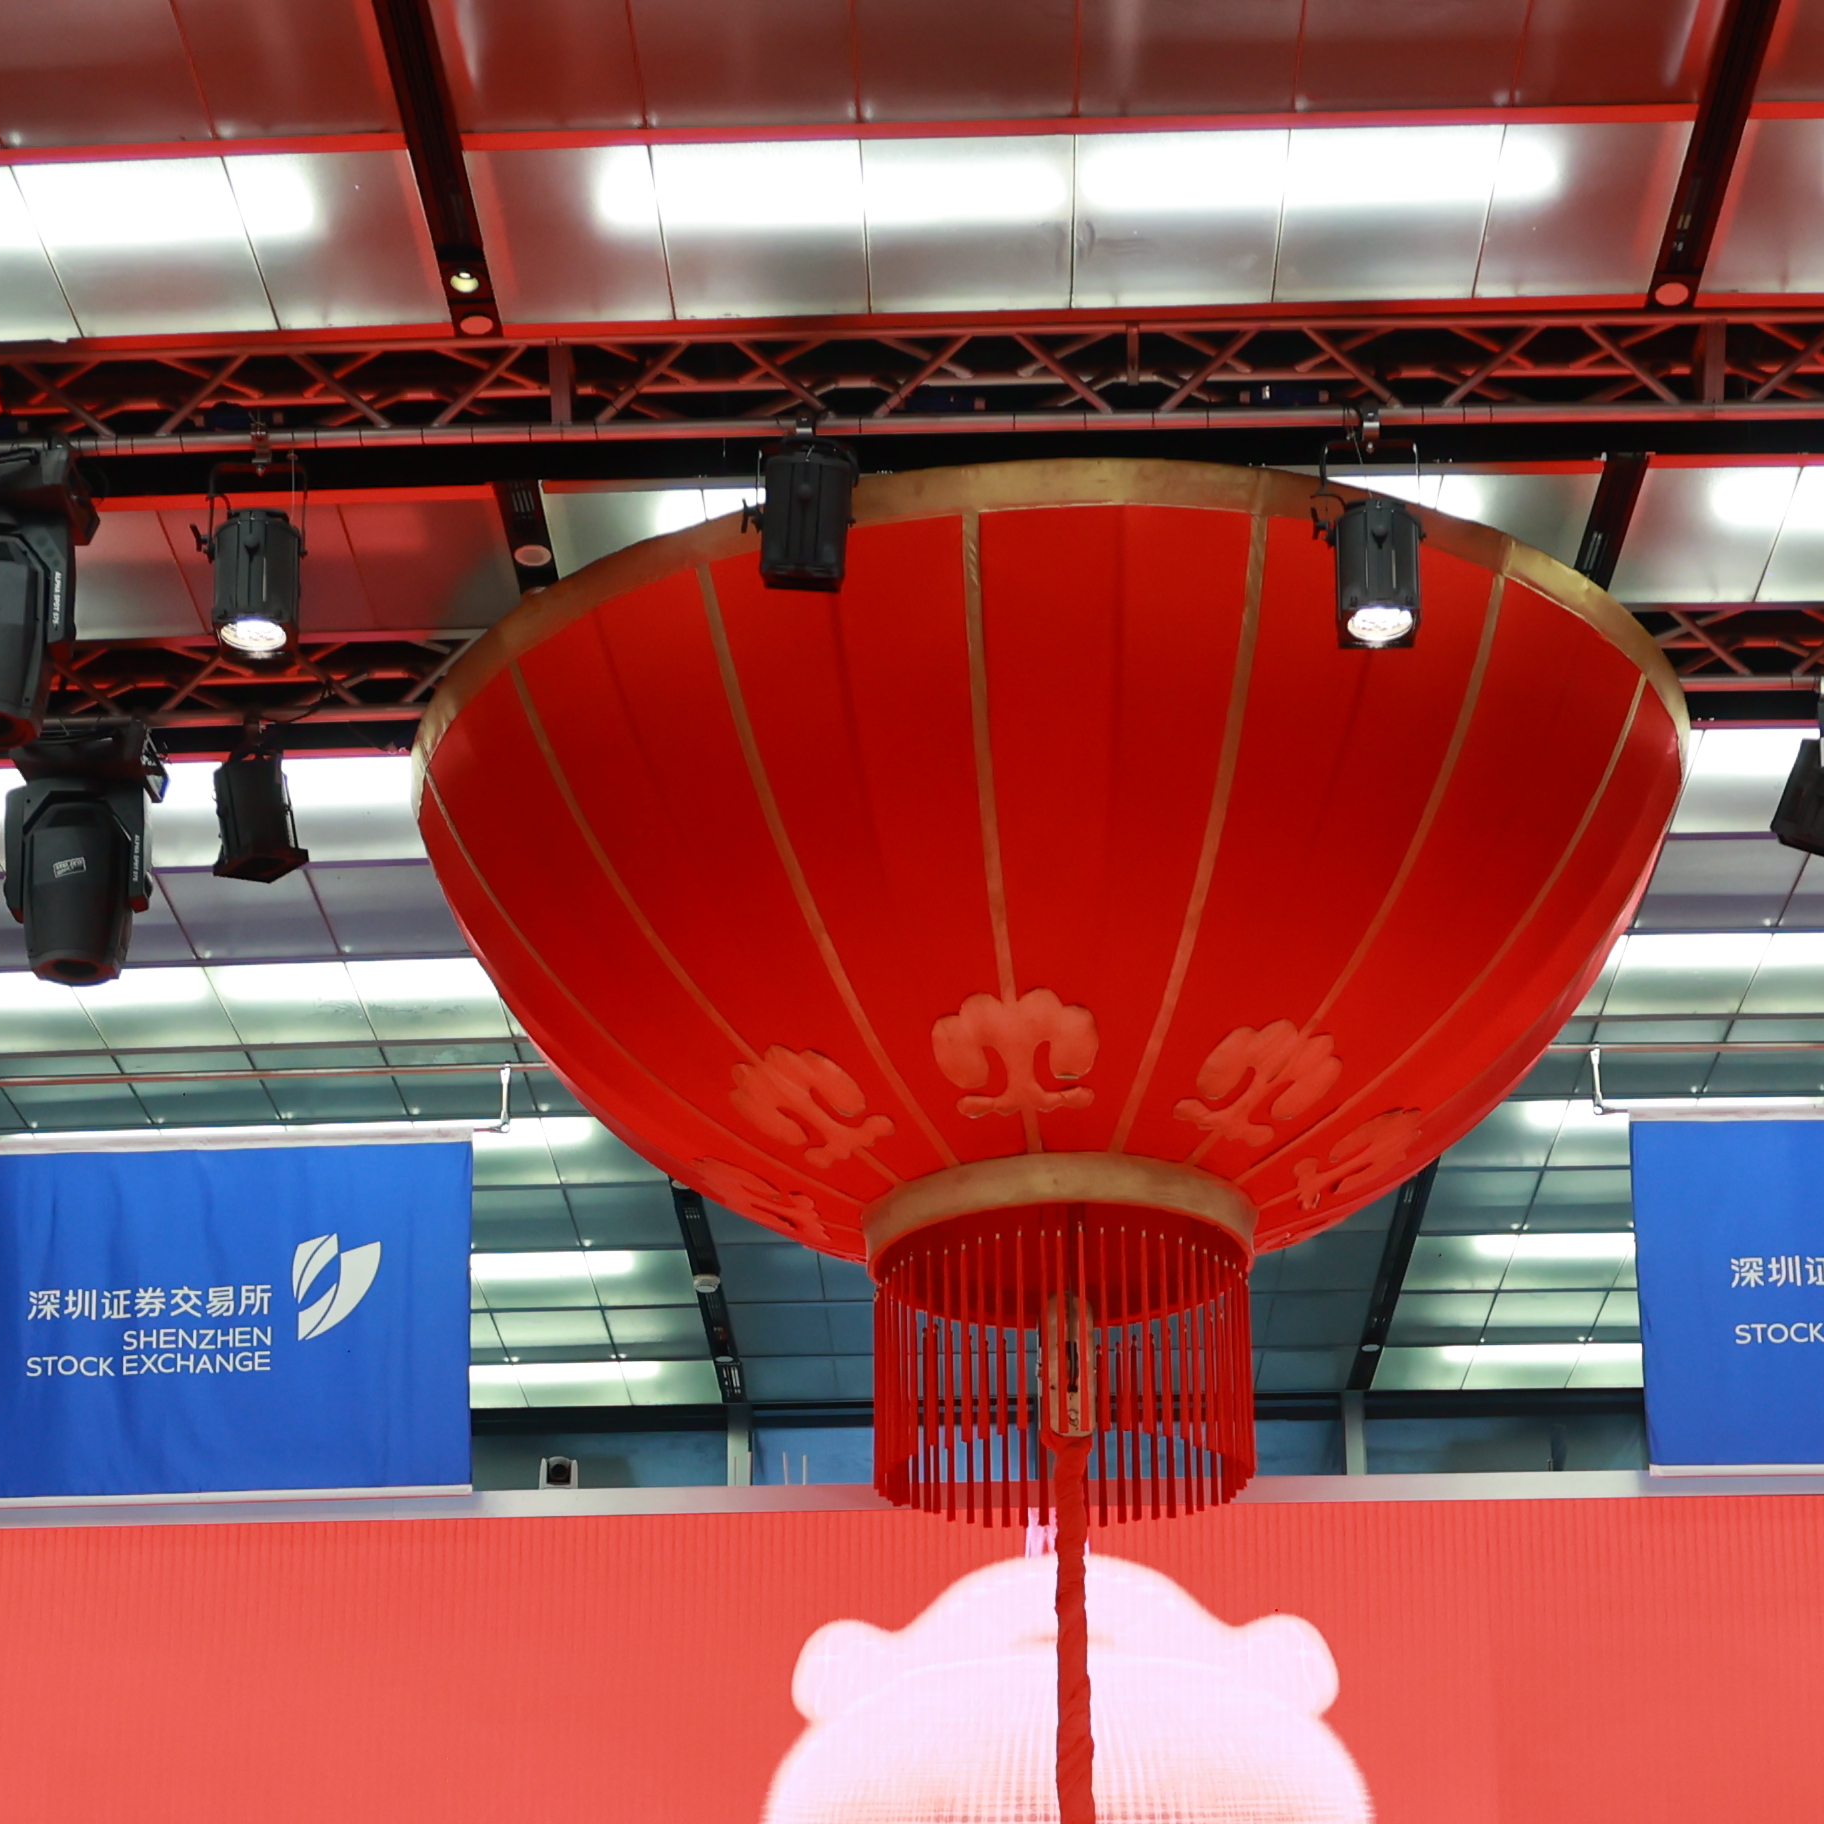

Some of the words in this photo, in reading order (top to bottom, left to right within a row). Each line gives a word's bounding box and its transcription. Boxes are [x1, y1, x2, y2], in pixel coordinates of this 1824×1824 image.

[27, 1284, 272, 1321] 深圳证券交易所
[122, 1326, 272, 1351] SHENZHEN
[26, 1355, 115, 1377] STOCK
[122, 1351, 271, 1375] EXCHANGE
